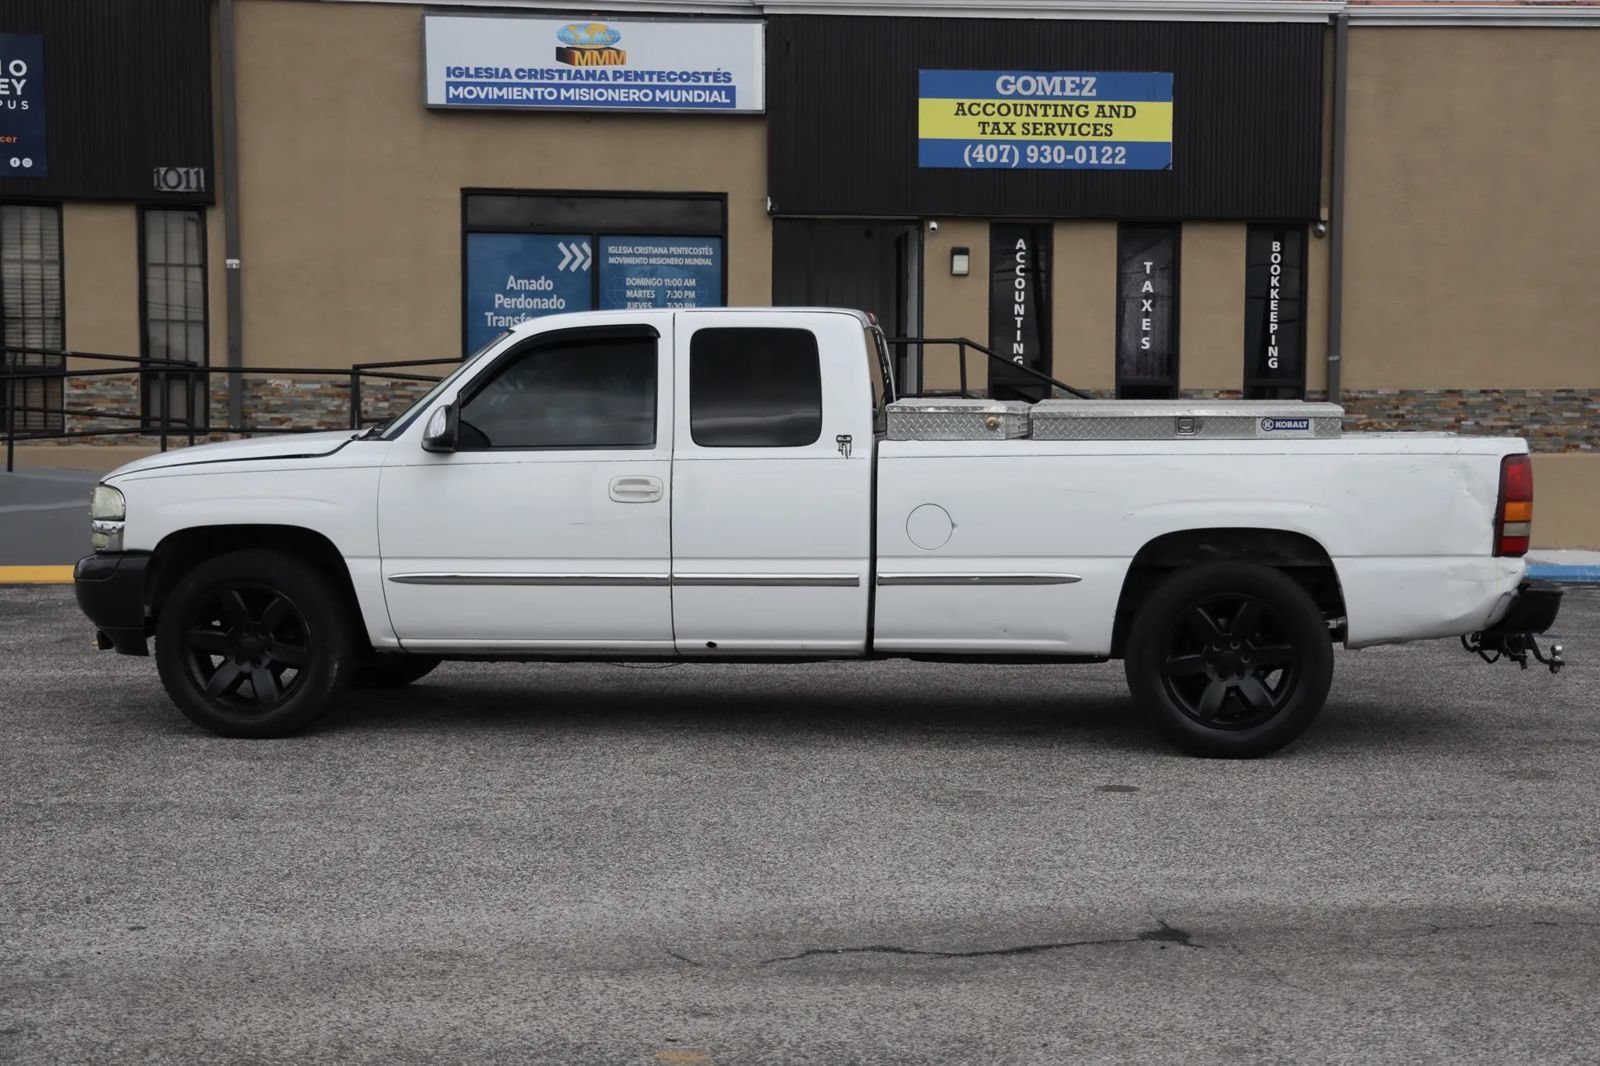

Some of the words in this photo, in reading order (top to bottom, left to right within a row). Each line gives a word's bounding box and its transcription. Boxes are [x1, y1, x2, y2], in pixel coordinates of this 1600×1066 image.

[573, 48, 627, 67] MMM
[0, 59, 27, 76] O
[446, 66, 513, 80] IGLESIA
[514, 68, 610, 82] CRISTIANA
[612, 68, 733, 83] PENTECOSTÉS
[995, 75, 1097, 96] GOMEZ
[448, 86, 558, 100] MOVIMIENTO
[560, 87, 653, 102] MISIONERO
[655, 89, 731, 103] MUNDIAL
[953, 102, 1090, 118] ACCOUNTING
[1094, 104, 1137, 119] AND
[978, 121, 1017, 136] TAX
[1021, 122, 1114, 137] SERVICES
[963, 143, 1020, 168] (407)
[1026, 146, 1127, 165] 930-0122
[153, 167, 205, 192] 1011
[607, 246, 633, 254] IGLESIA
[633, 247, 668, 255] CRISTIANA
[669, 245, 714, 255] PENTECOSTÉS
[608, 257, 648, 265] MOVIMIENTO
[649, 257, 684, 265] MISIONERO
[685, 258, 713, 266] MUNDIAL
[506, 275, 554, 291] Amado
[625, 277, 662, 287] DOMINGO
[664, 278, 682, 287] 11:00
[684, 279, 696, 287] AM
[494, 293, 566, 309] Perdonado
[626, 289, 656, 299] MARTES
[666, 290, 683, 299] 7:30
[684, 290, 696, 299] PM
[1013, 238, 1027, 365] ACCOUNTING
[1141, 261, 1154, 350] TAXES
[1267, 241, 1282, 369] BOOKKEEPING
[1275, 420, 1308, 429] KOBALT
